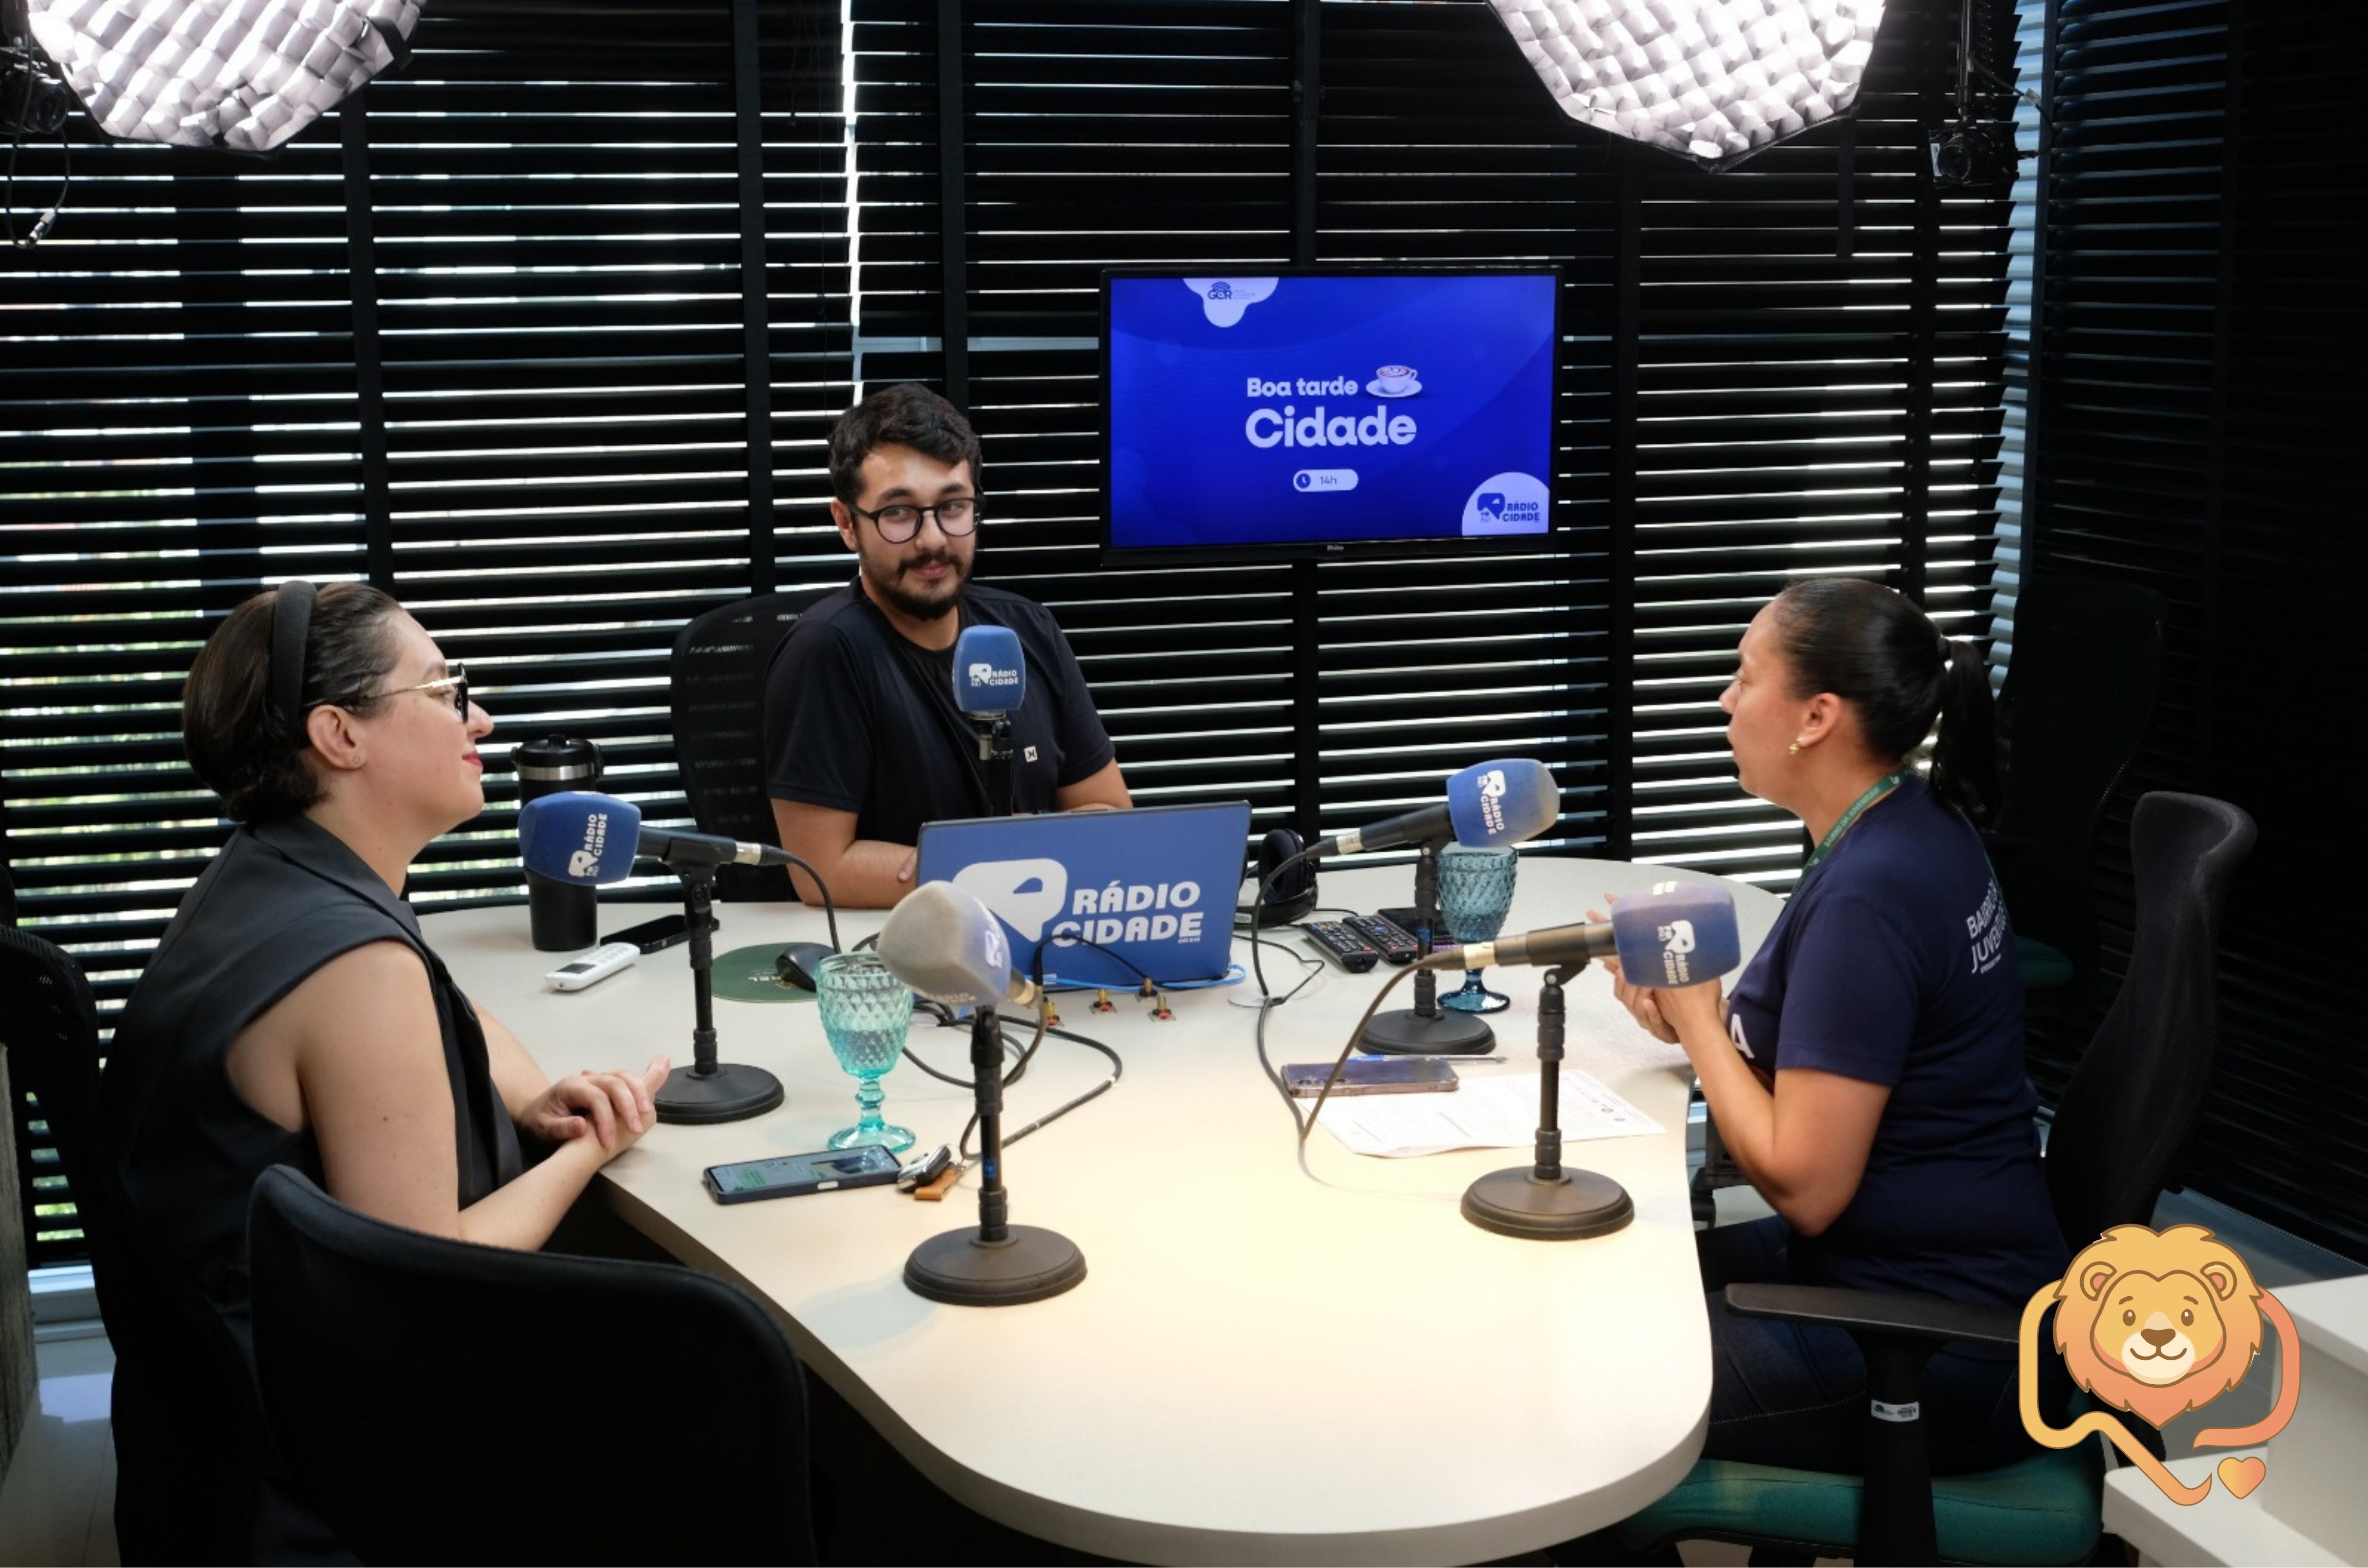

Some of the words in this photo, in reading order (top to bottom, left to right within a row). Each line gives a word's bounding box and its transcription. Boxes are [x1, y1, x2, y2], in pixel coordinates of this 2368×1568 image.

[1247, 377, 1292, 397] Boa
[1296, 376, 1358, 396] tarde
[1246, 405, 1417, 448] Cidade
[1320, 477, 1337, 485] 14h
[1502, 512, 1540, 522] CIDADE
[1507, 500, 1539, 511] RÁDIO
[989, 677, 1018, 686] CIDADE
[992, 669, 1017, 677] RÁDIO
[1480, 795, 1497, 835] CIDADE
[1489, 797, 1505, 831] RÁDIO
[584, 814, 598, 851] RÁDIO
[594, 813, 608, 856] CIDADE
[1072, 880, 1201, 915] RÁDIO
[1052, 912, 1204, 947] CIDADE
[1663, 951, 1679, 985] CIDADE
